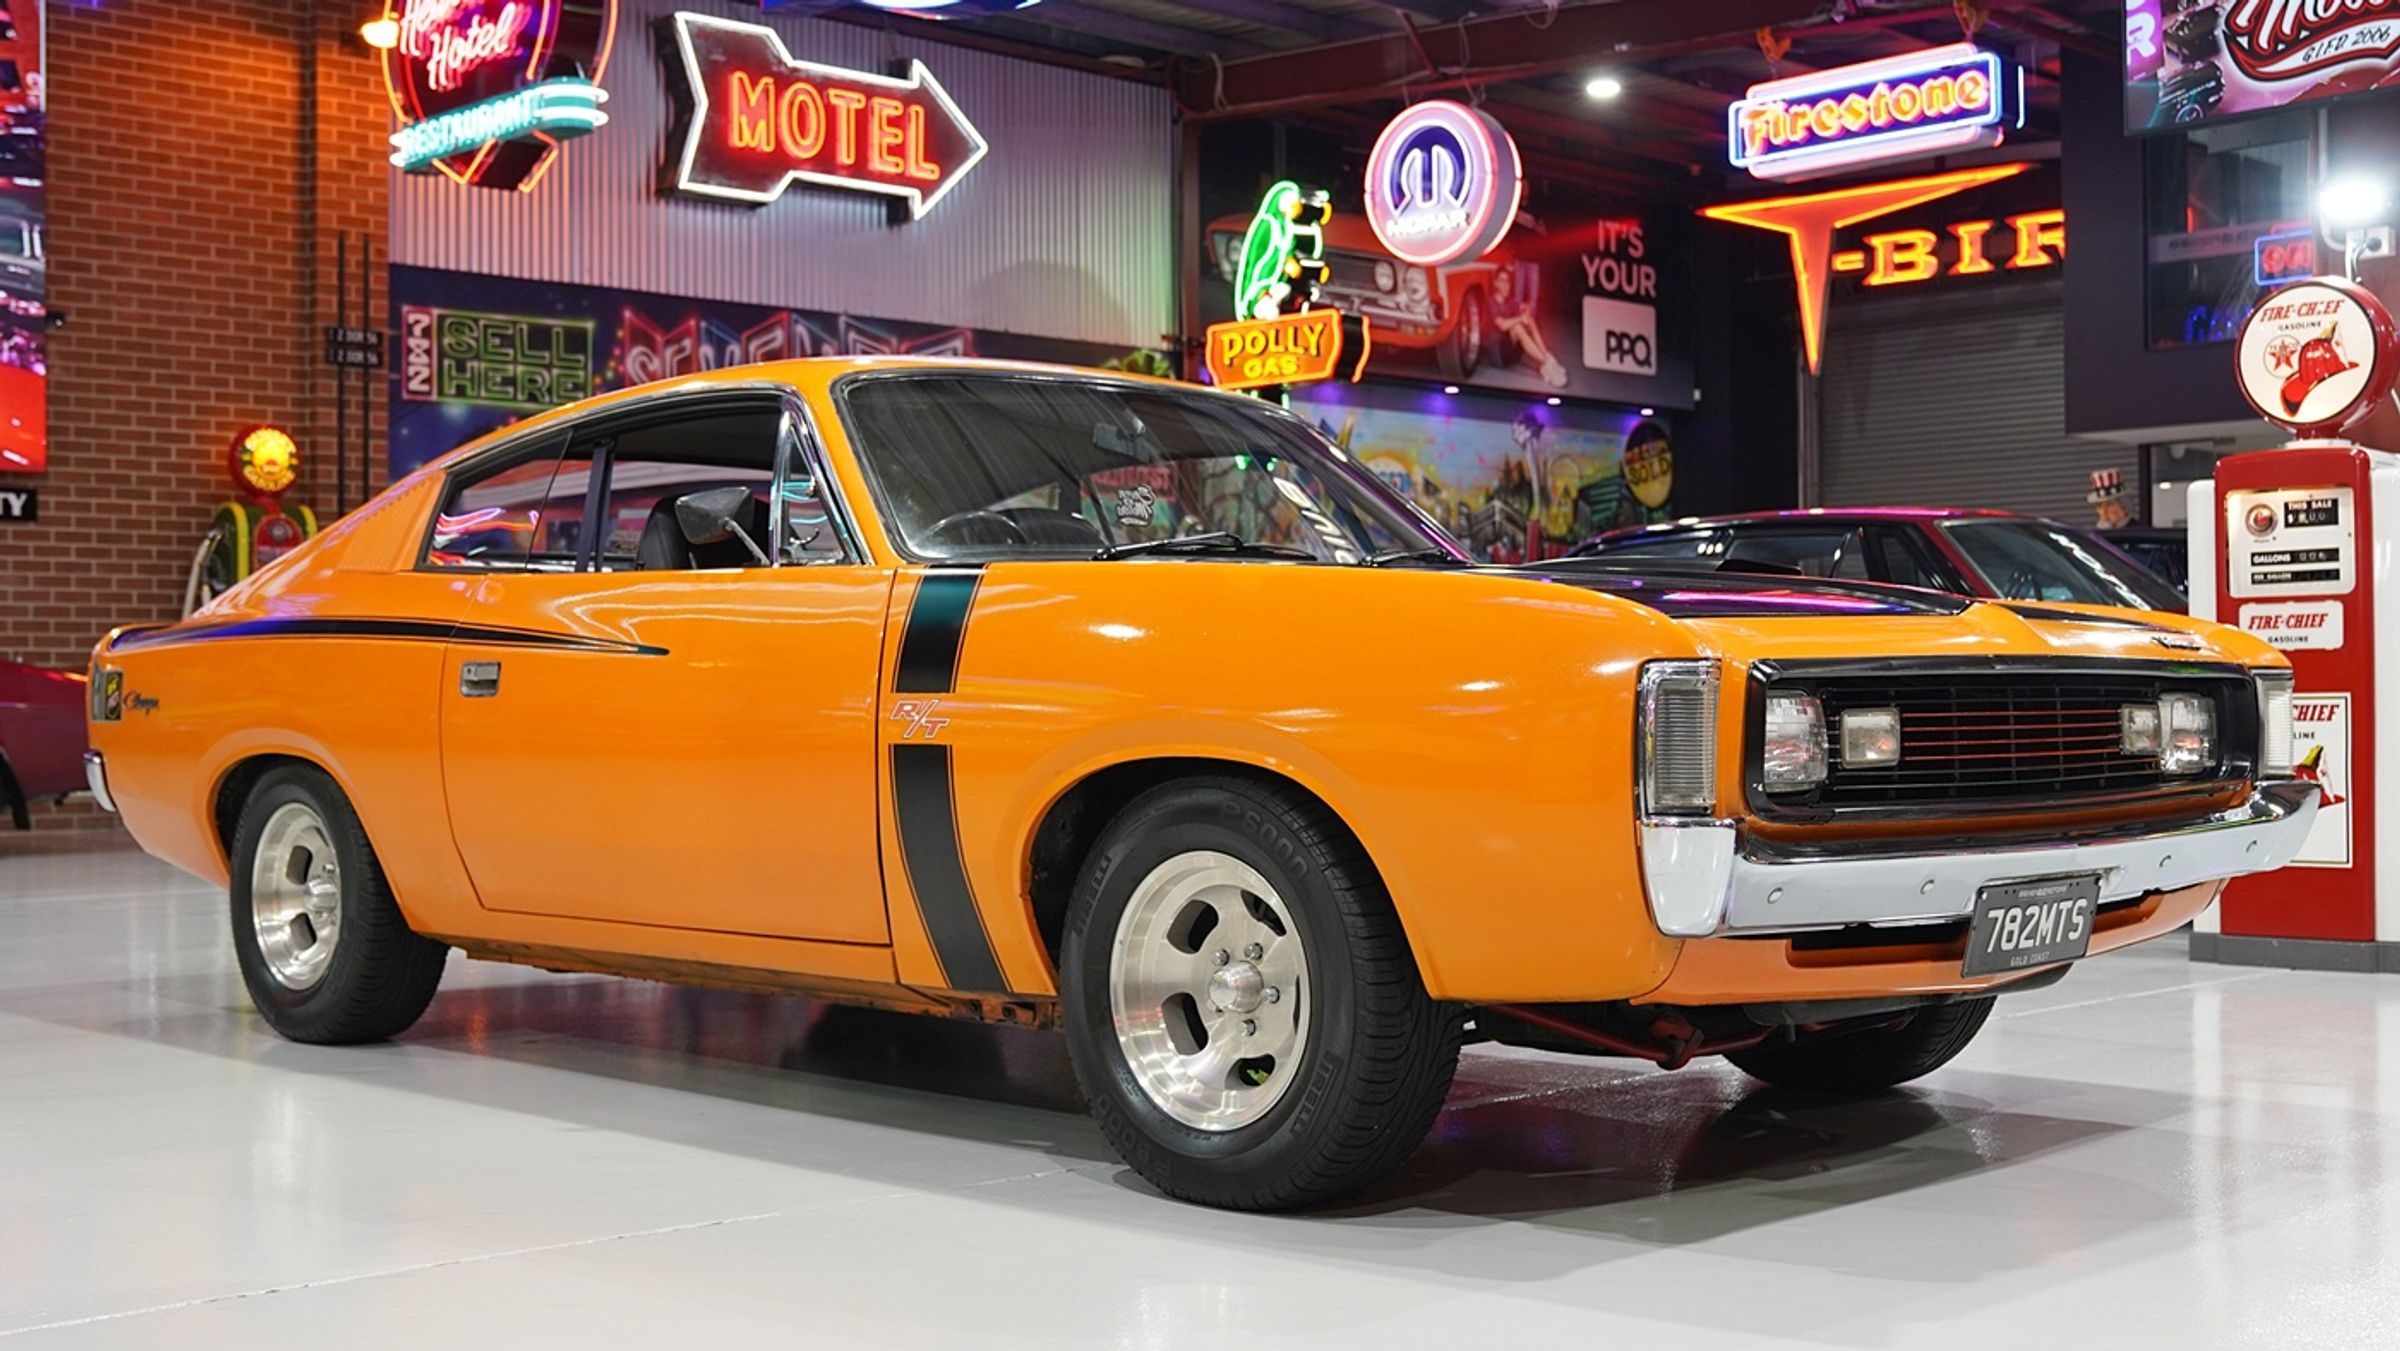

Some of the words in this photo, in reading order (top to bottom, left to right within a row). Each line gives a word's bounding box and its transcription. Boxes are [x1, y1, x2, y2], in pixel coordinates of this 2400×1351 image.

[427, 2, 516, 90] Hotel
[2351, 26, 2391, 47] 2006
[403, 90, 537, 162] RESTAURANT
[732, 70, 940, 181] MOTEL
[1741, 69, 1989, 158] Firestone
[1598, 219, 1645, 258] IT'S
[1581, 253, 1657, 298] YOUR
[443, 316, 588, 368] SELL
[1221, 321, 1326, 366] POLLY
[1606, 329, 1653, 369] PPQ
[443, 358, 587, 402] HERE
[1243, 354, 1298, 379] GAS
[1629, 456, 1671, 487] SOLD
[2311, 499, 2333, 509] SALE
[2252, 552, 2291, 564] GALLONS
[2247, 613, 2329, 630] FIRE-CHIEF
[2267, 635, 2309, 644] GASOLINE
[890, 699, 951, 738] R/T
[1986, 897, 2088, 953] 782MTS
[2010, 954, 2029, 968] GOLD
